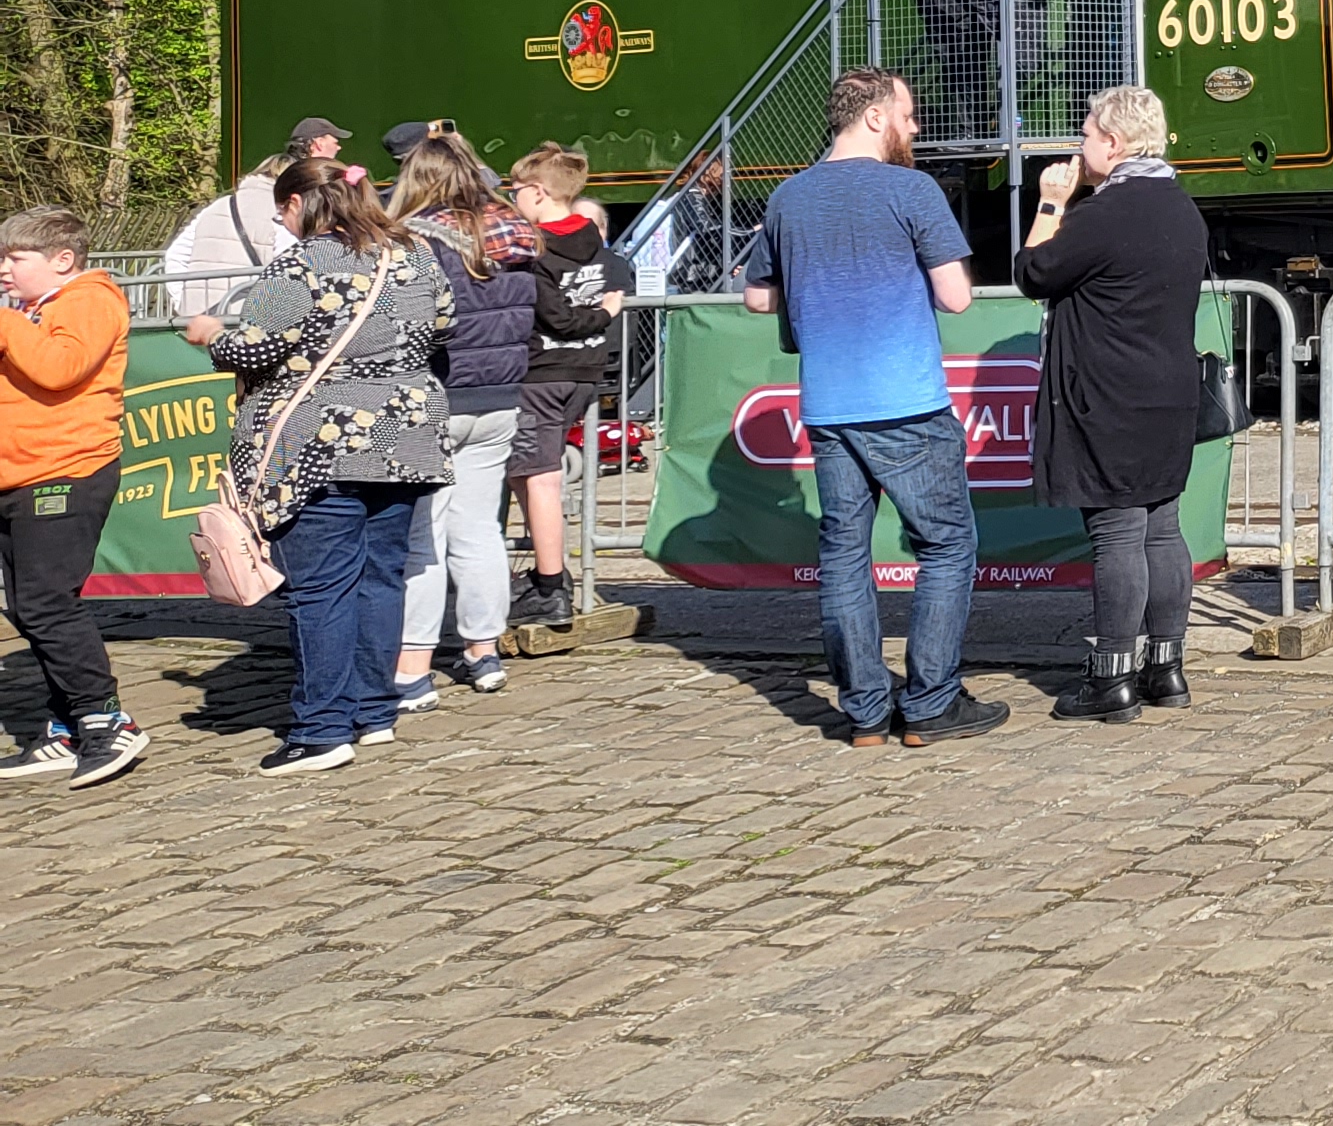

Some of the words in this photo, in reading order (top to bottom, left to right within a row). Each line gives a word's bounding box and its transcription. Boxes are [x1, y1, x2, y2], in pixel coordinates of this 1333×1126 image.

[528, 43, 558, 53] BRITISH
[119, 397, 216, 449] LYING
[118, 483, 155, 504] 1923
[875, 567, 920, 582] WOR
[990, 567, 1055, 581] RAILWAY
